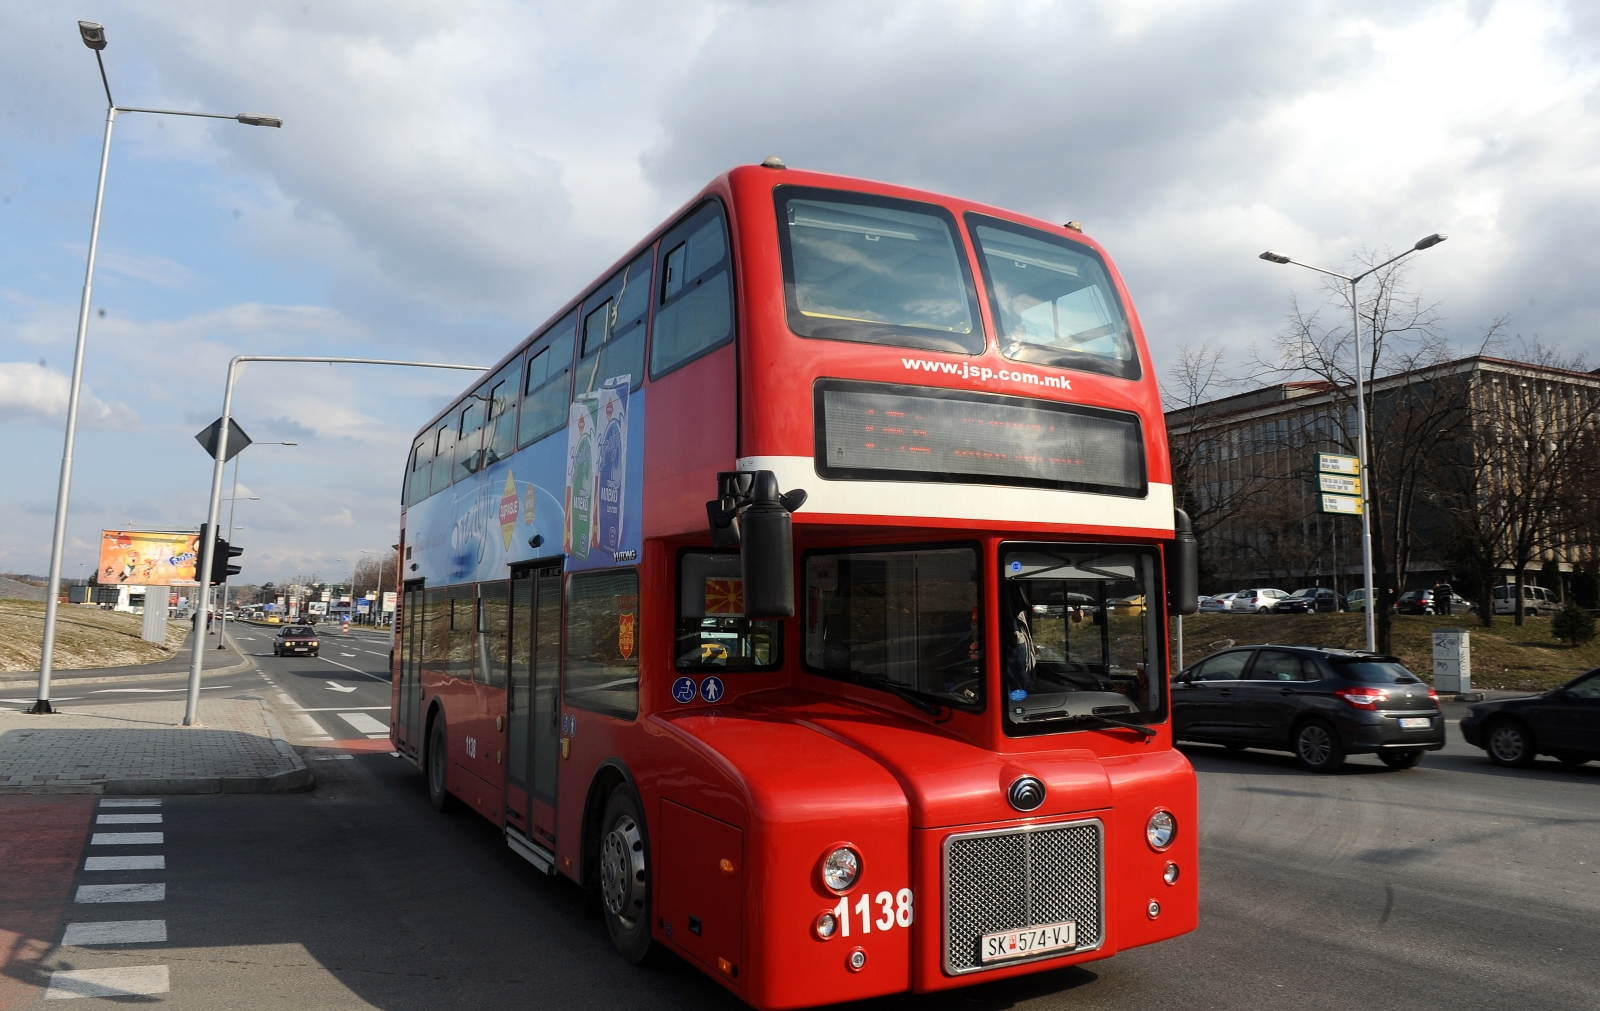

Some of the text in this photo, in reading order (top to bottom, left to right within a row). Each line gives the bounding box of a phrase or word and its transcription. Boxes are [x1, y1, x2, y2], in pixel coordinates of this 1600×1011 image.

[901, 357, 1072, 391] www.jsp.com.mk
[500, 500, 518, 520] ЗДРАВЈЕ
[613, 549, 637, 562] YUTONG
[465, 734, 476, 759] 1138
[834, 888, 914, 938] 1138
[988, 925, 1071, 956] SK 574-VJ
